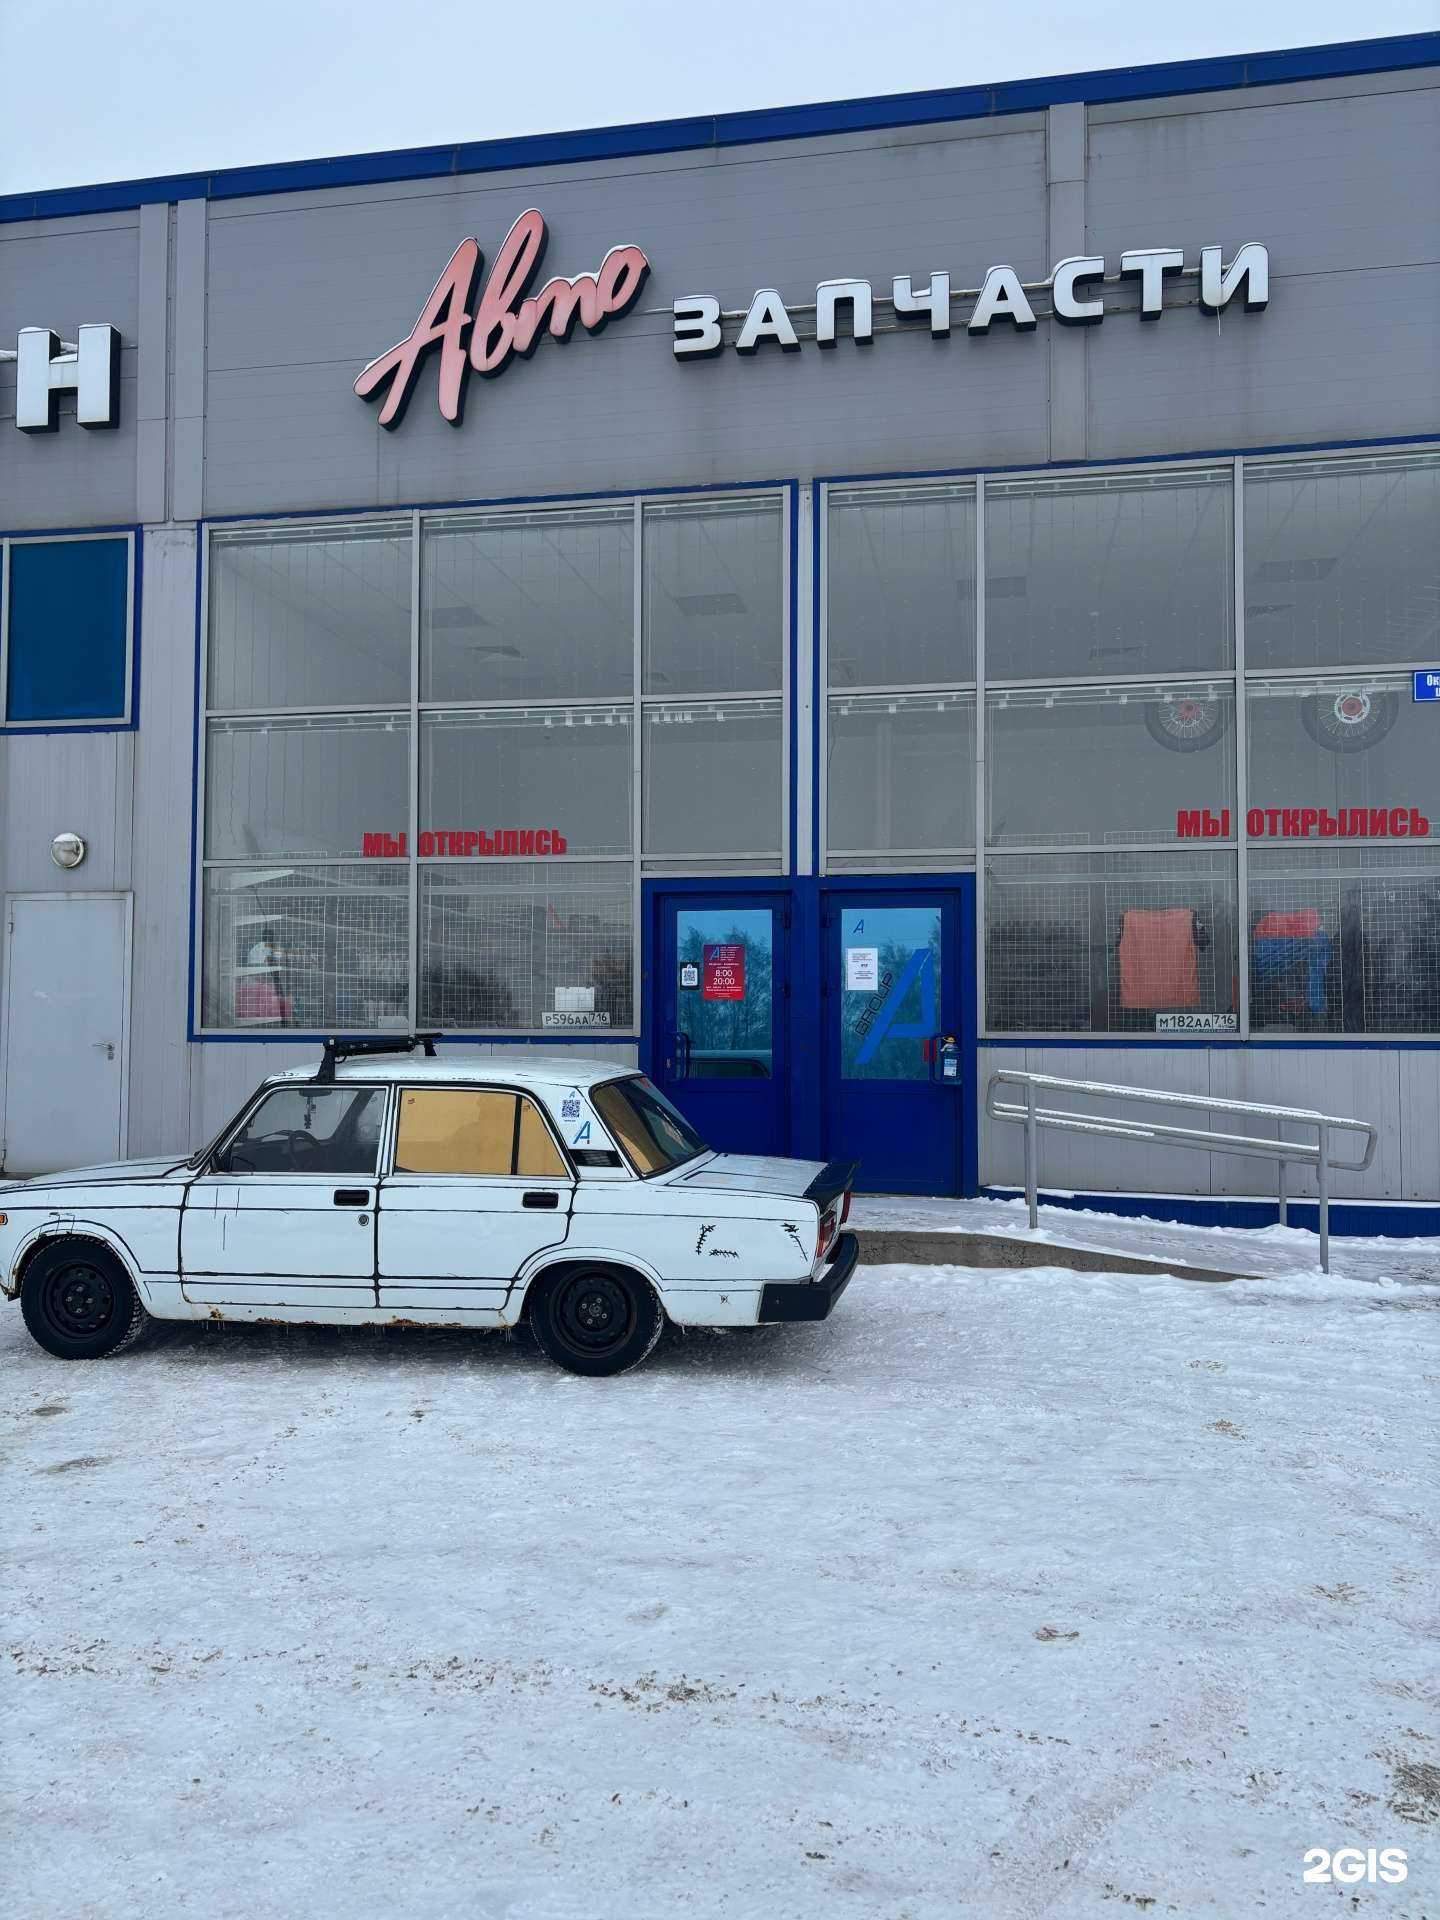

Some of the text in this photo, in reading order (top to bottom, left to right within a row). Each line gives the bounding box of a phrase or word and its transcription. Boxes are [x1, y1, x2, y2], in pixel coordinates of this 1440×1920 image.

[353, 208, 1270, 432] Авто ЗАПЧАСТИ
[1177, 808, 1429, 837] МЫ ОТКРЫЛИСЬ
[363, 829, 567, 857] МЫ ОТКРЫЛИСЬ
[715, 969, 733, 977] 8:00
